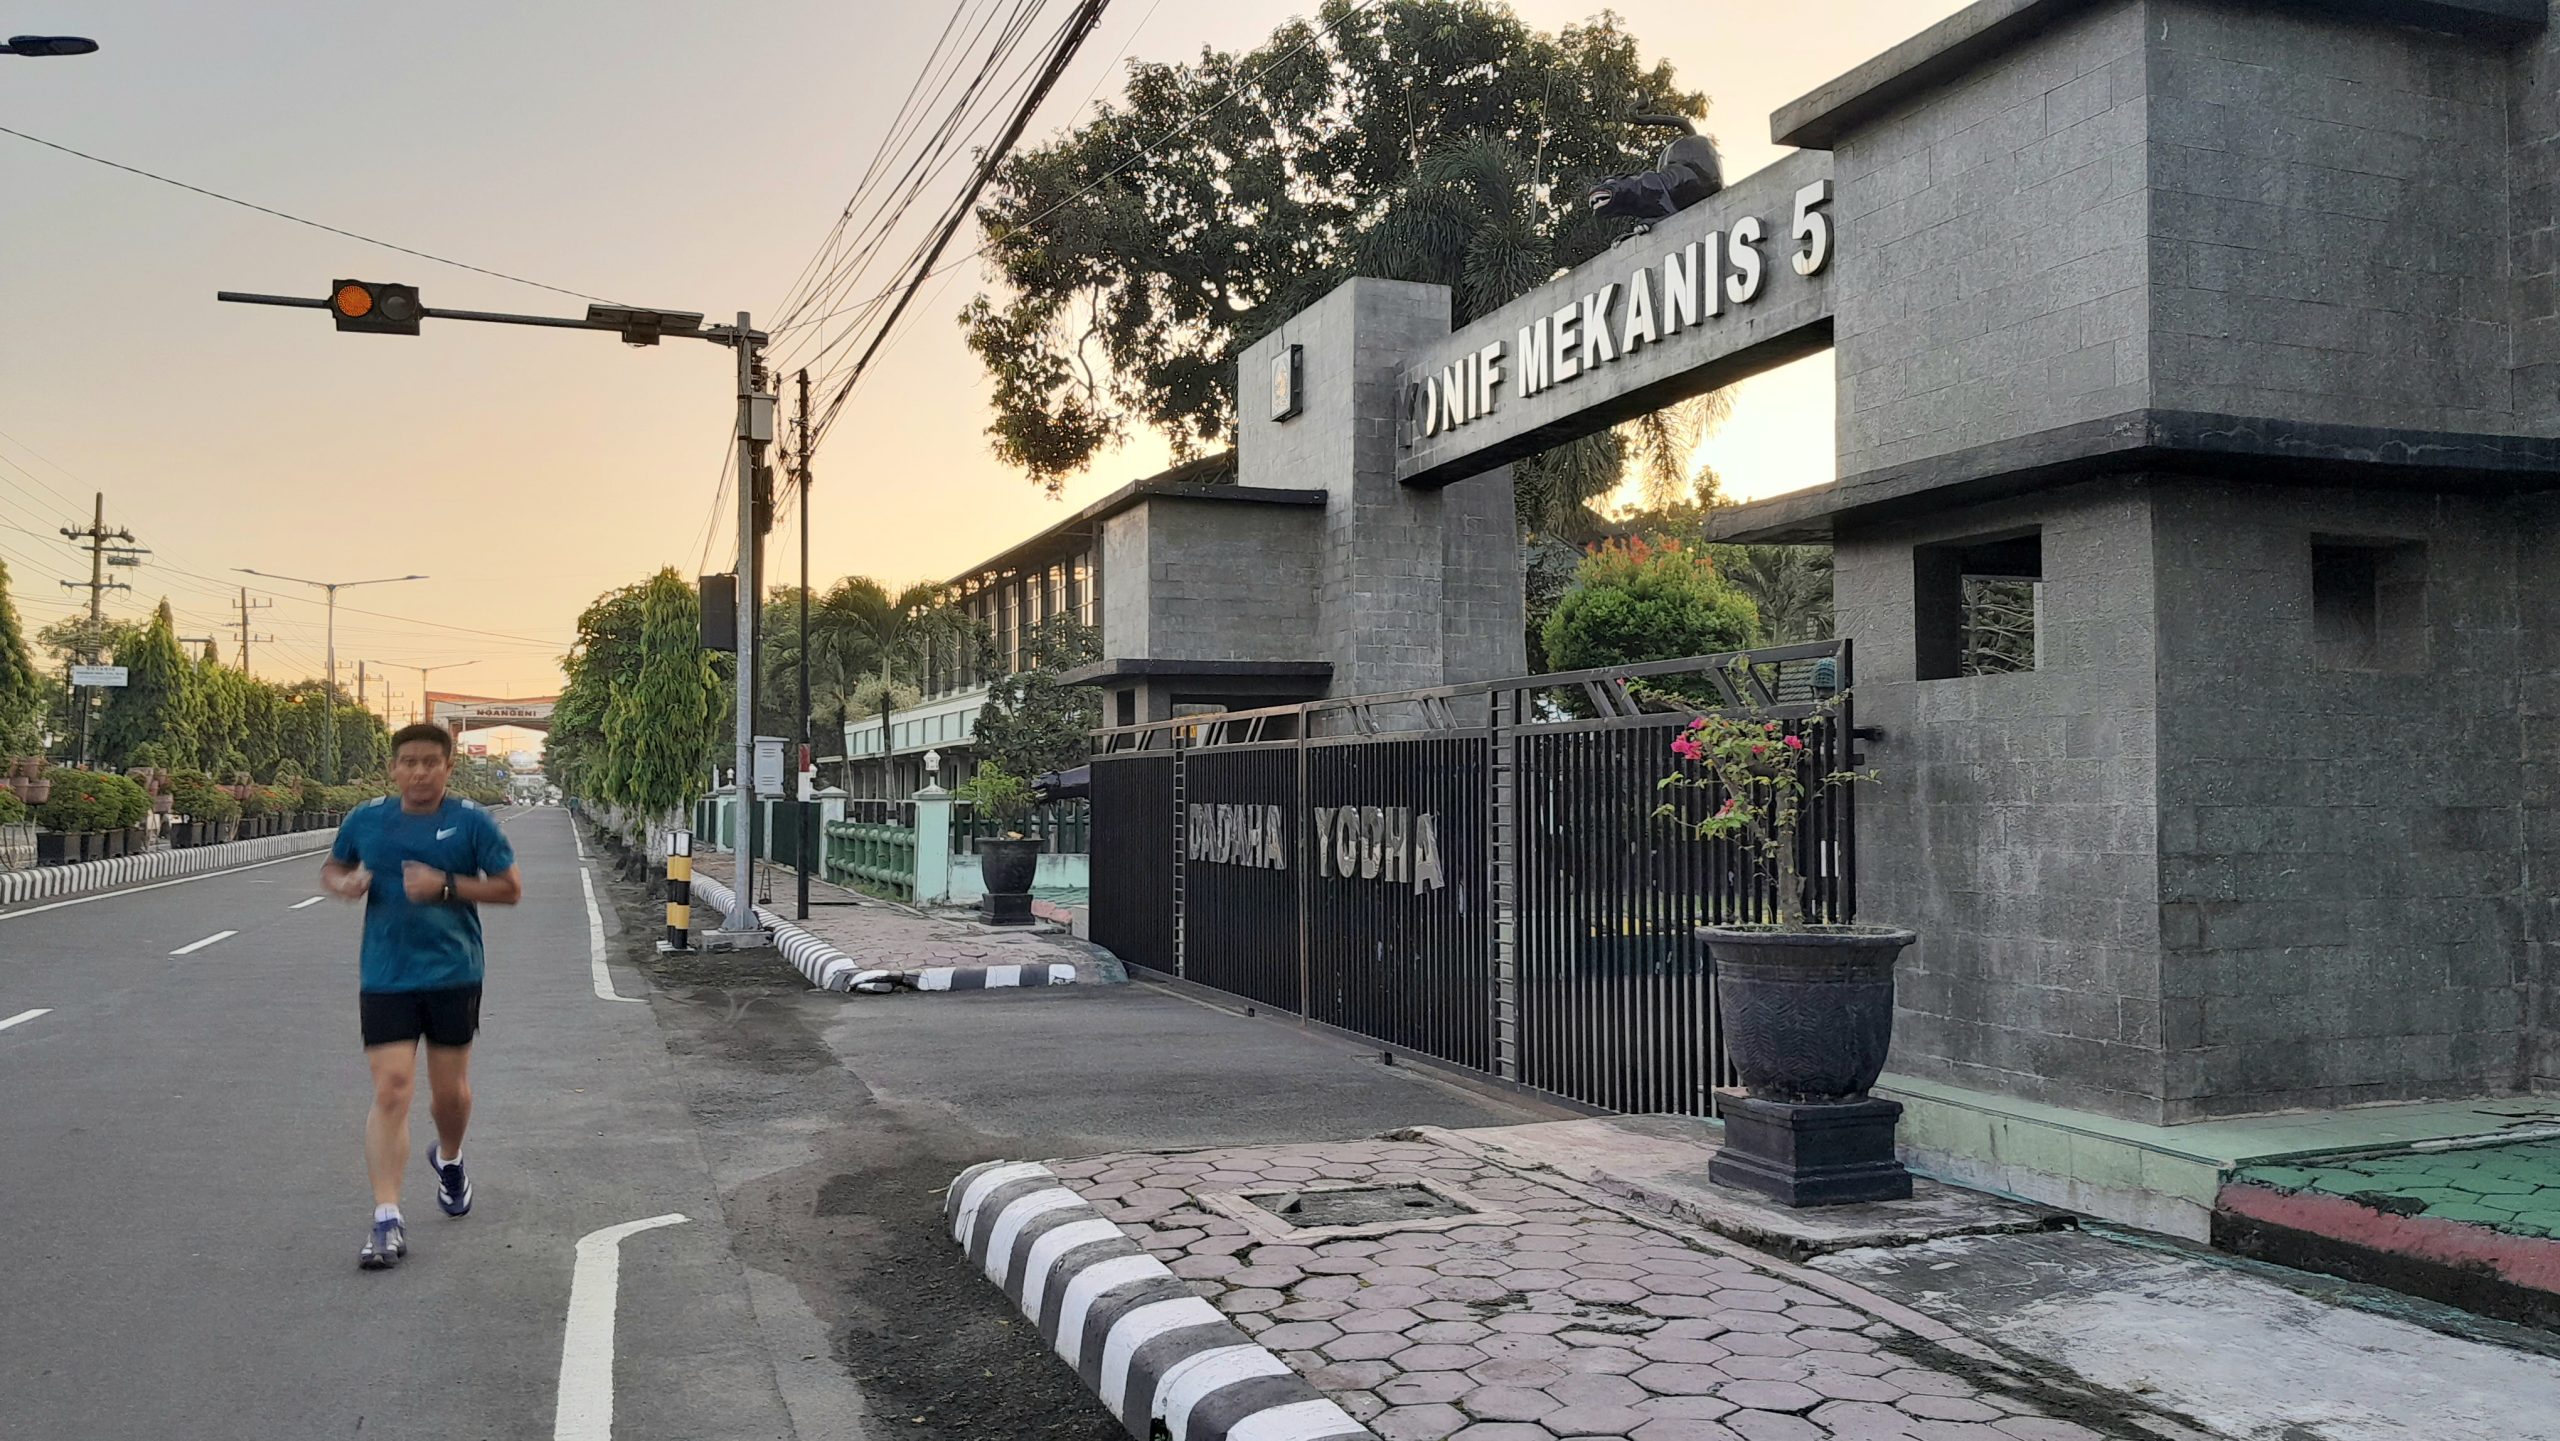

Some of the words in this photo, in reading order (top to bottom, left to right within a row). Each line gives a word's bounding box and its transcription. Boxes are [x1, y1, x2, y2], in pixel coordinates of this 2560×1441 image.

[1394, 340, 1506, 448] YONIF
[1518, 216, 1766, 398] MEKANIS
[1189, 803, 1287, 870] DADAHA
[1314, 805, 1445, 895] YODHA
